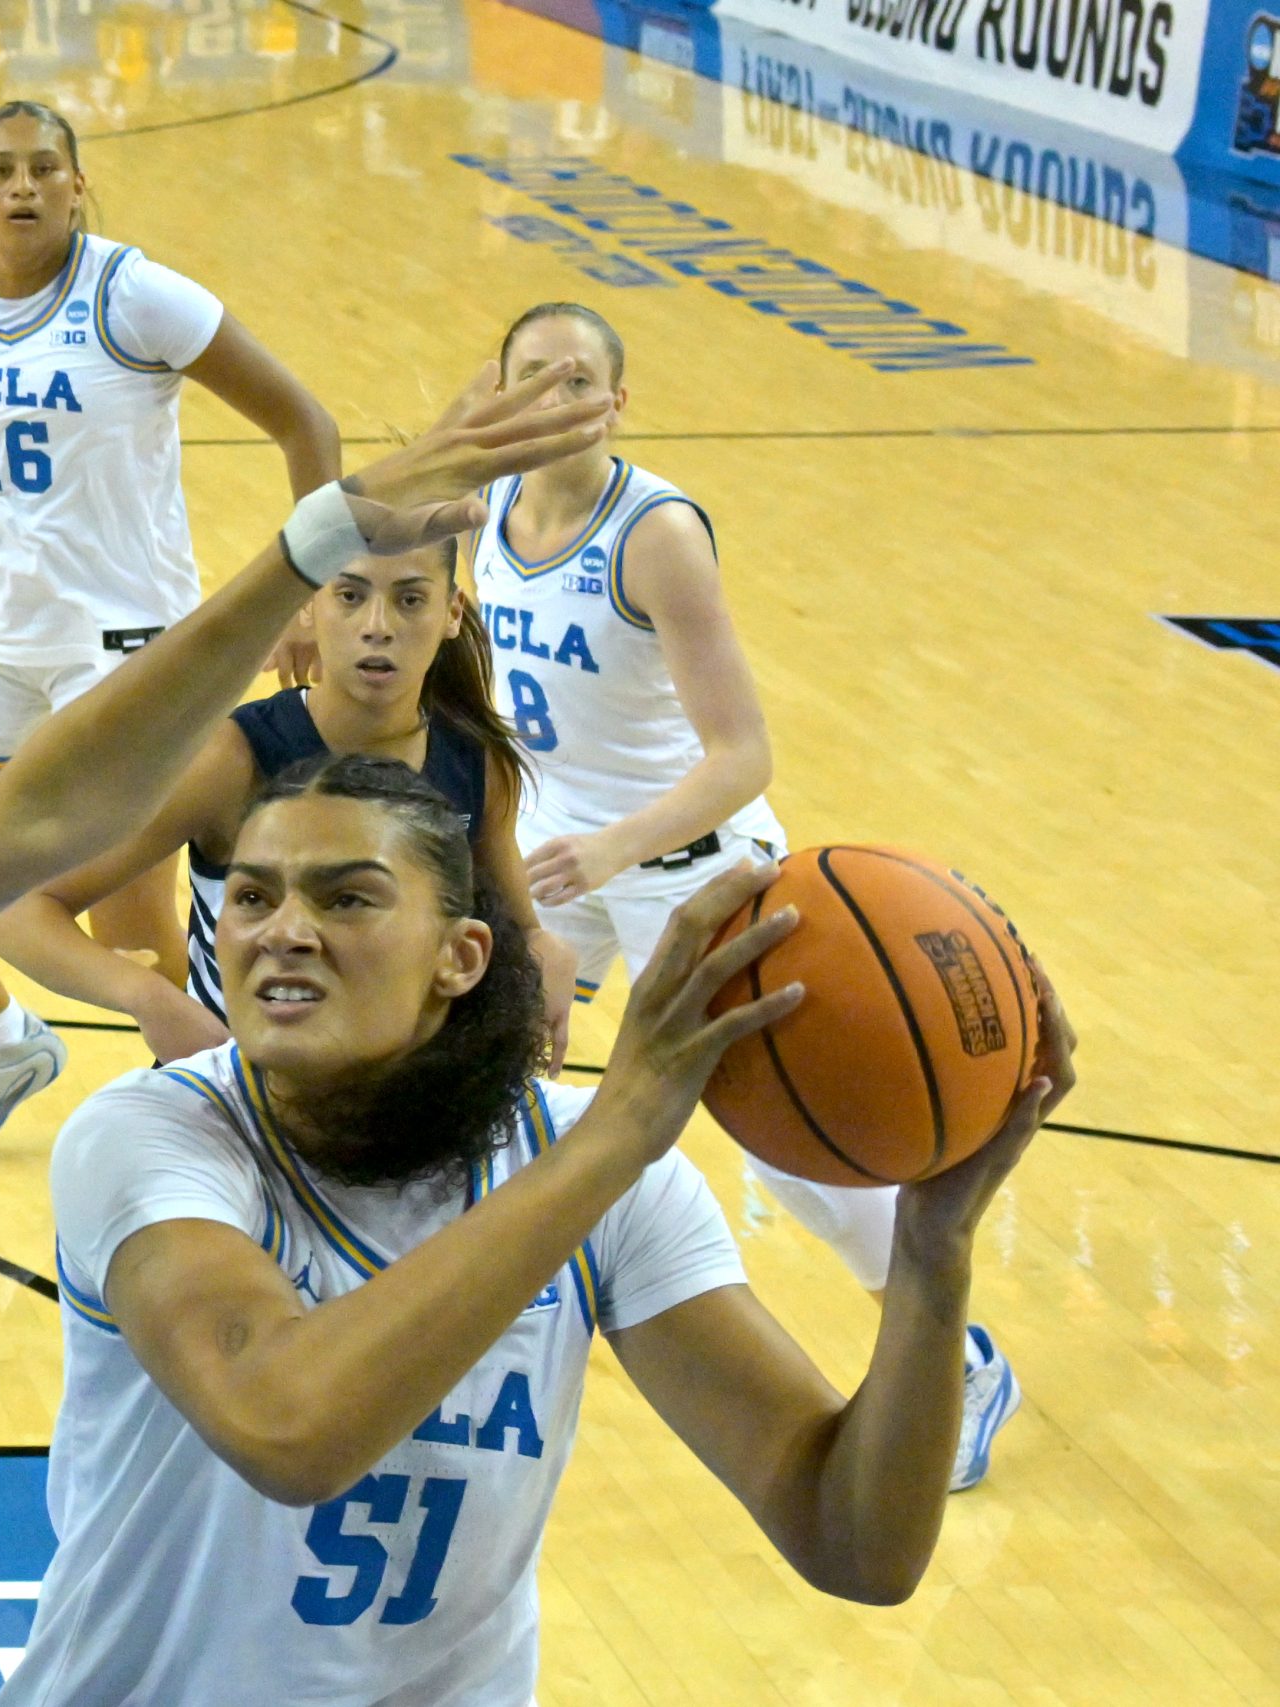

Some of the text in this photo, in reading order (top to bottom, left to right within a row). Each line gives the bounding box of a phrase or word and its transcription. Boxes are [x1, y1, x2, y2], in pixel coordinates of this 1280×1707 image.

[976, 0, 1174, 108] ROUNDS
[507, 668, 560, 753] 8
[290, 1472, 468, 1626] 51
